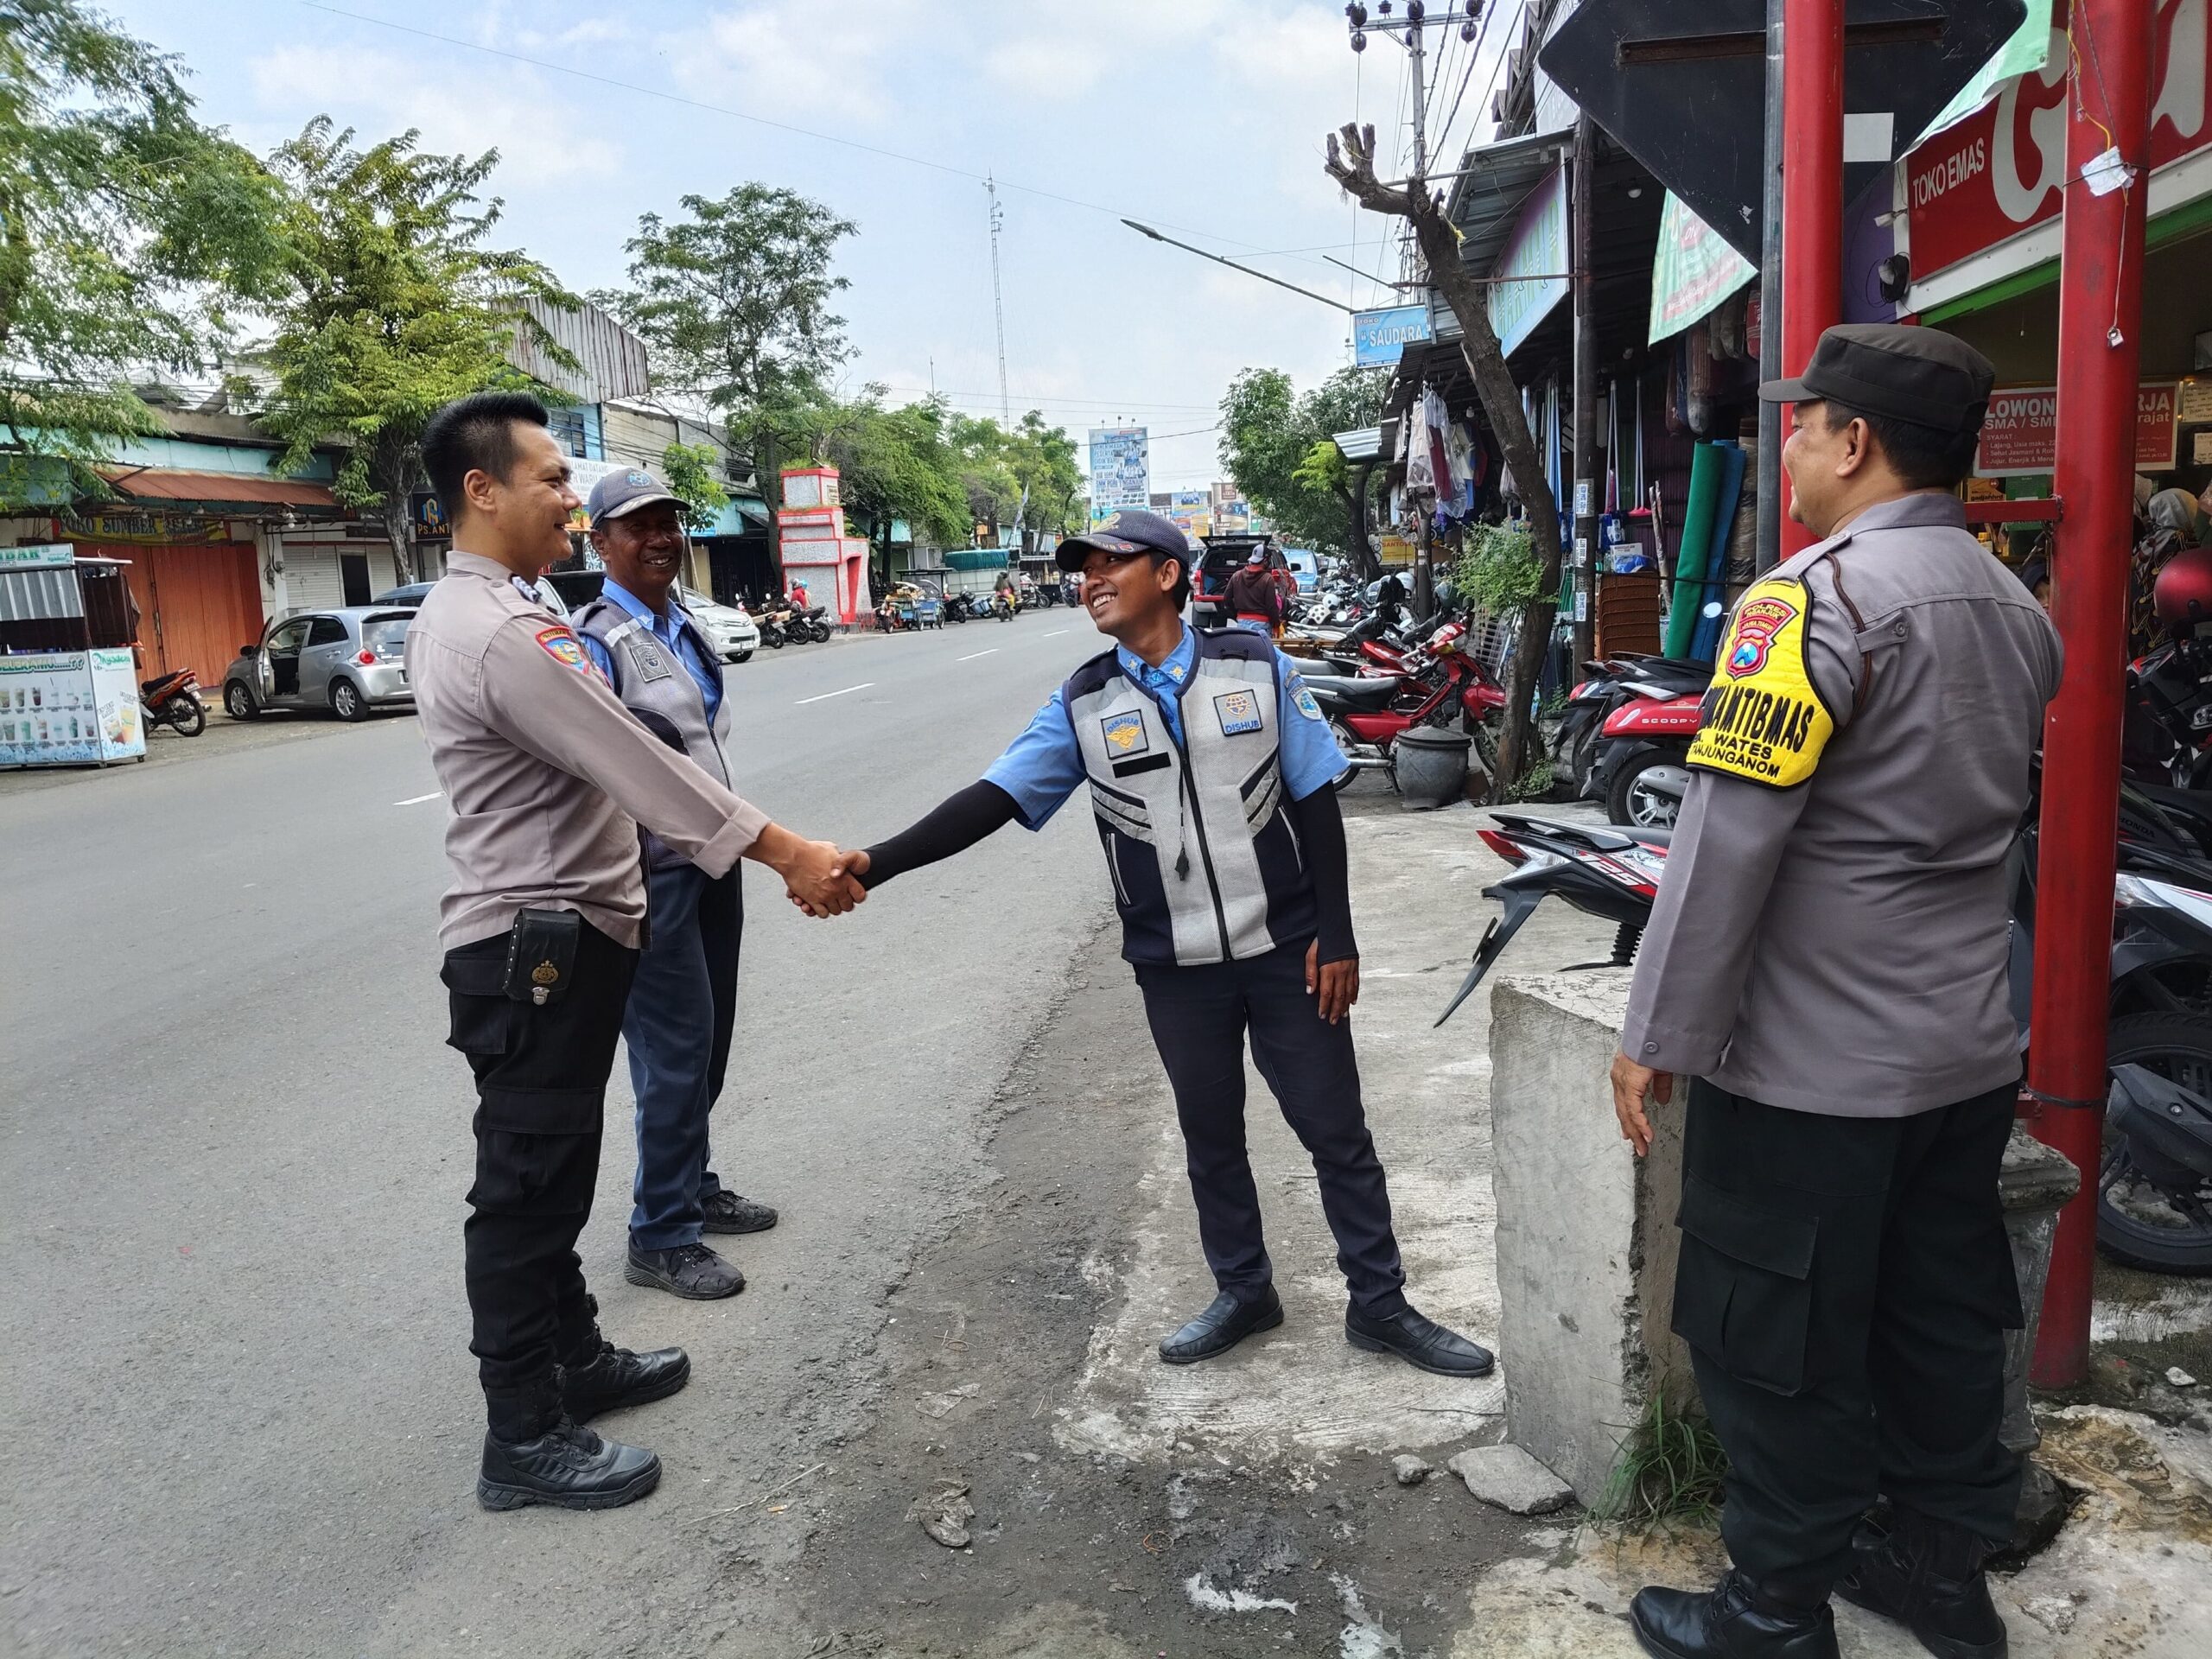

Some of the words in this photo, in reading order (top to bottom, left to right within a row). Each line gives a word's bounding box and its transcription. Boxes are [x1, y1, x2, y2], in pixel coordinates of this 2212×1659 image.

[1912, 161, 1947, 209] TOKO
[1948, 137, 1985, 190] EMAS
[1370, 324, 1423, 347] SAUDARA
[1985, 398, 2056, 419] LOWON
[1985, 418, 2018, 430] SMA
[2031, 416, 2056, 428] SM
[2138, 412, 2170, 425] rajat
[1744, 603, 1787, 617] POLRES
[1745, 608, 1780, 620] NGANJUK
[1107, 716, 1140, 734] DISHUB
[1224, 720, 1260, 734] DISHUB
[1714, 732, 1773, 760] WATES
